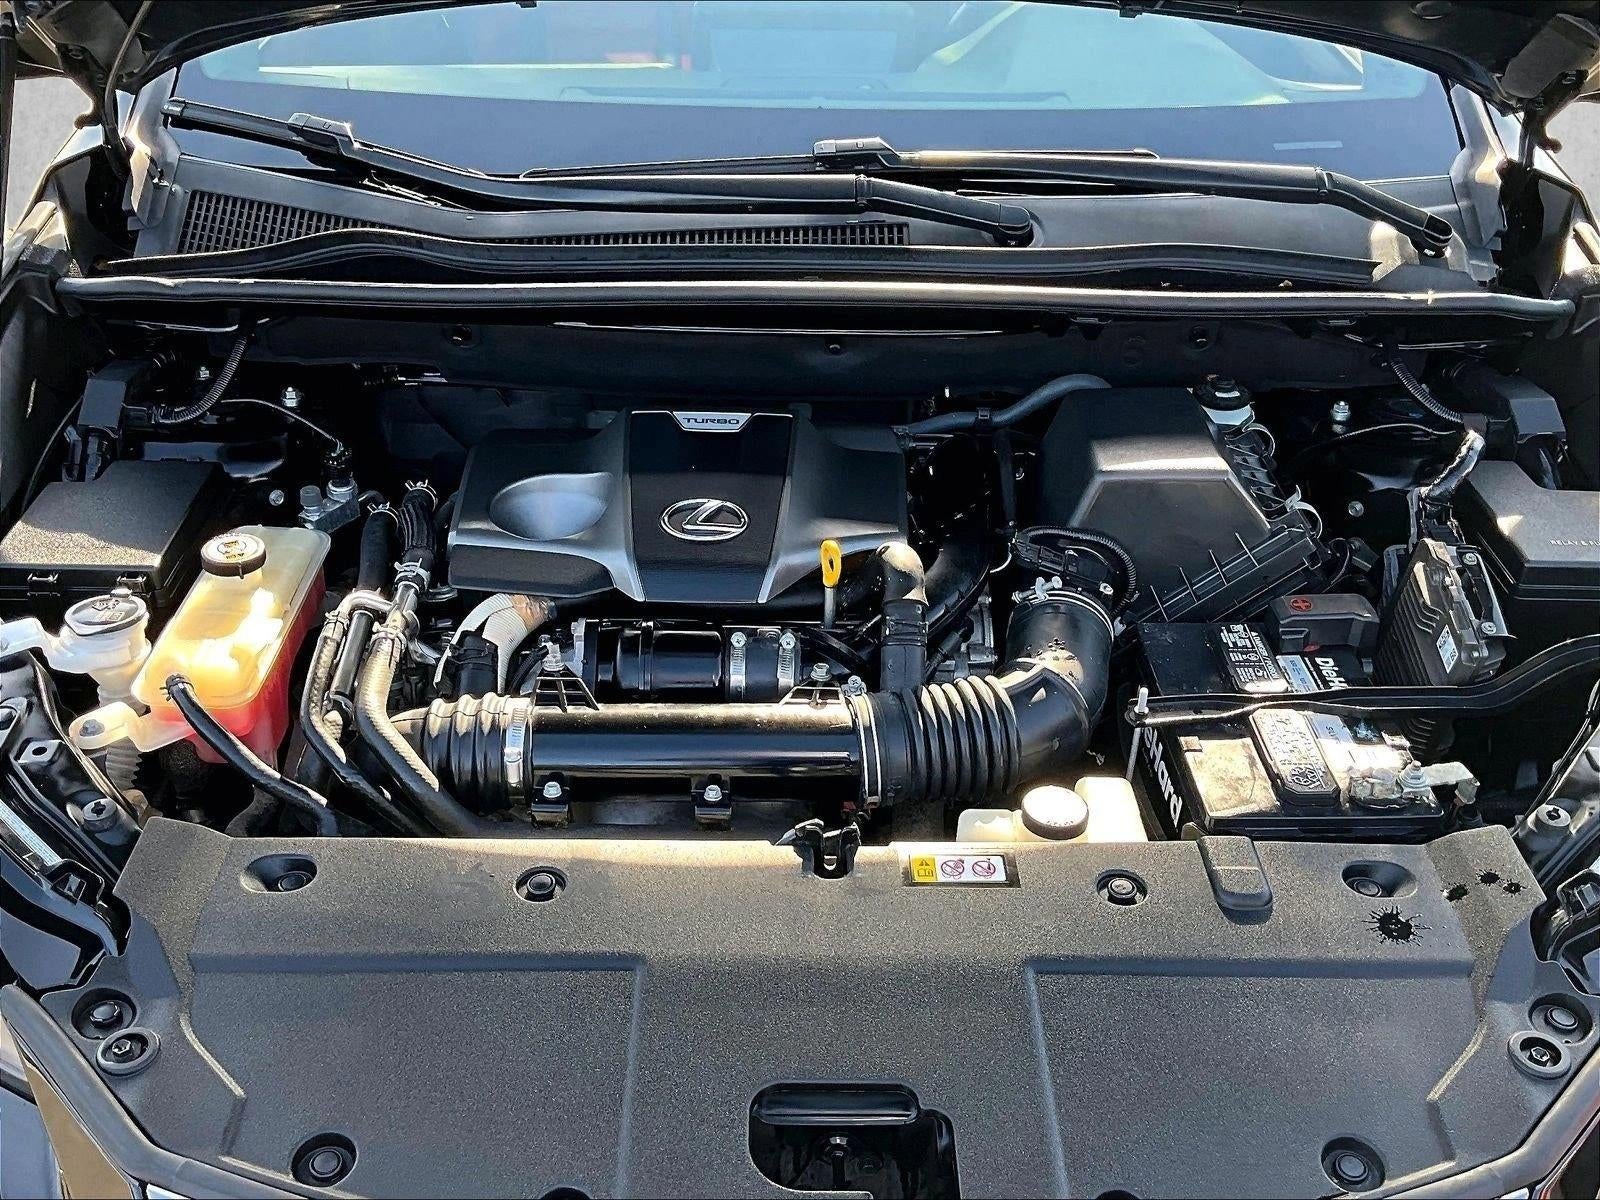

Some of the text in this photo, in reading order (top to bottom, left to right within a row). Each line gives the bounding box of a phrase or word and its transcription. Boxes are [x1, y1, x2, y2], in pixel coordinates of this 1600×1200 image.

[682, 417, 740, 425] TURBO
[1314, 657, 1348, 690] DieH
[1143, 727, 1183, 828] eHard
